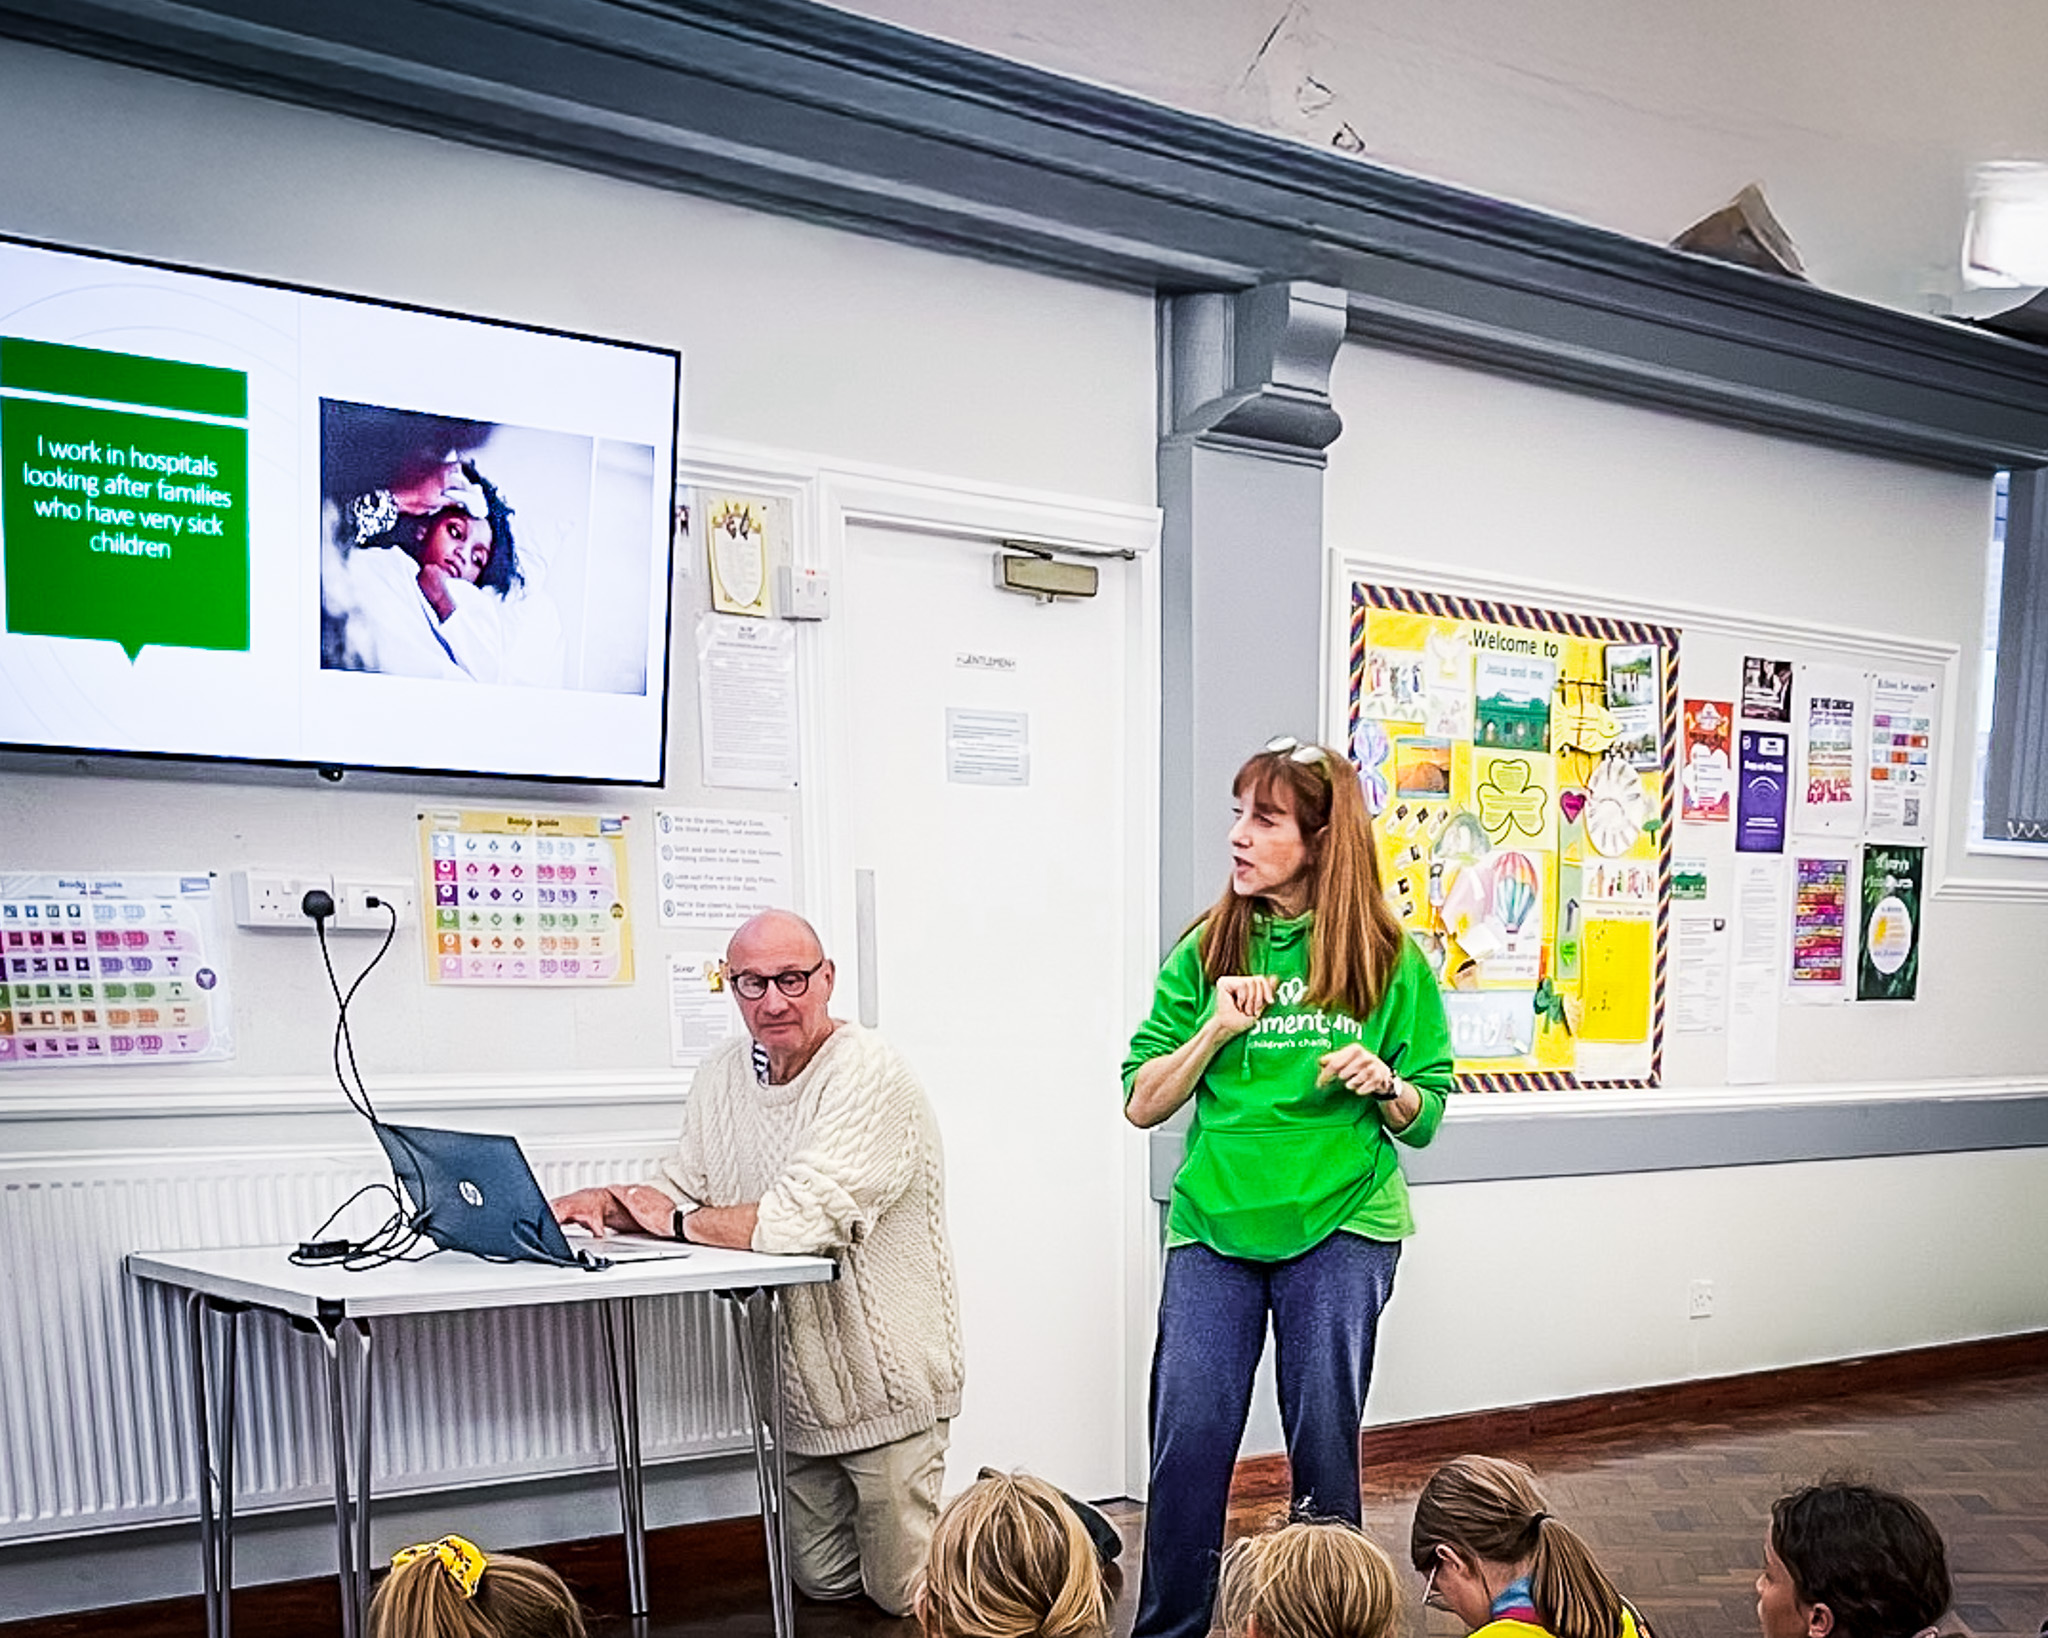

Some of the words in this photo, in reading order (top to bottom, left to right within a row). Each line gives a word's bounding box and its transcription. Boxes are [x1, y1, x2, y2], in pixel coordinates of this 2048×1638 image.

[37, 434, 43, 457] I
[49, 439, 102, 464] work
[106, 443, 125, 466] in
[130, 444, 218, 478] hospitals
[23, 461, 100, 498] looking
[104, 472, 153, 499] after
[156, 478, 233, 509] families
[33, 495, 82, 521] who
[86, 499, 136, 527] have
[139, 510, 184, 537] very
[187, 512, 224, 537] sick
[89, 529, 172, 560] children
[1473, 628, 1538, 656] Welcome
[1544, 640, 1559, 658] to
[58, 880, 91, 890] Badg
[1249, 1008, 1363, 1041] omentum
